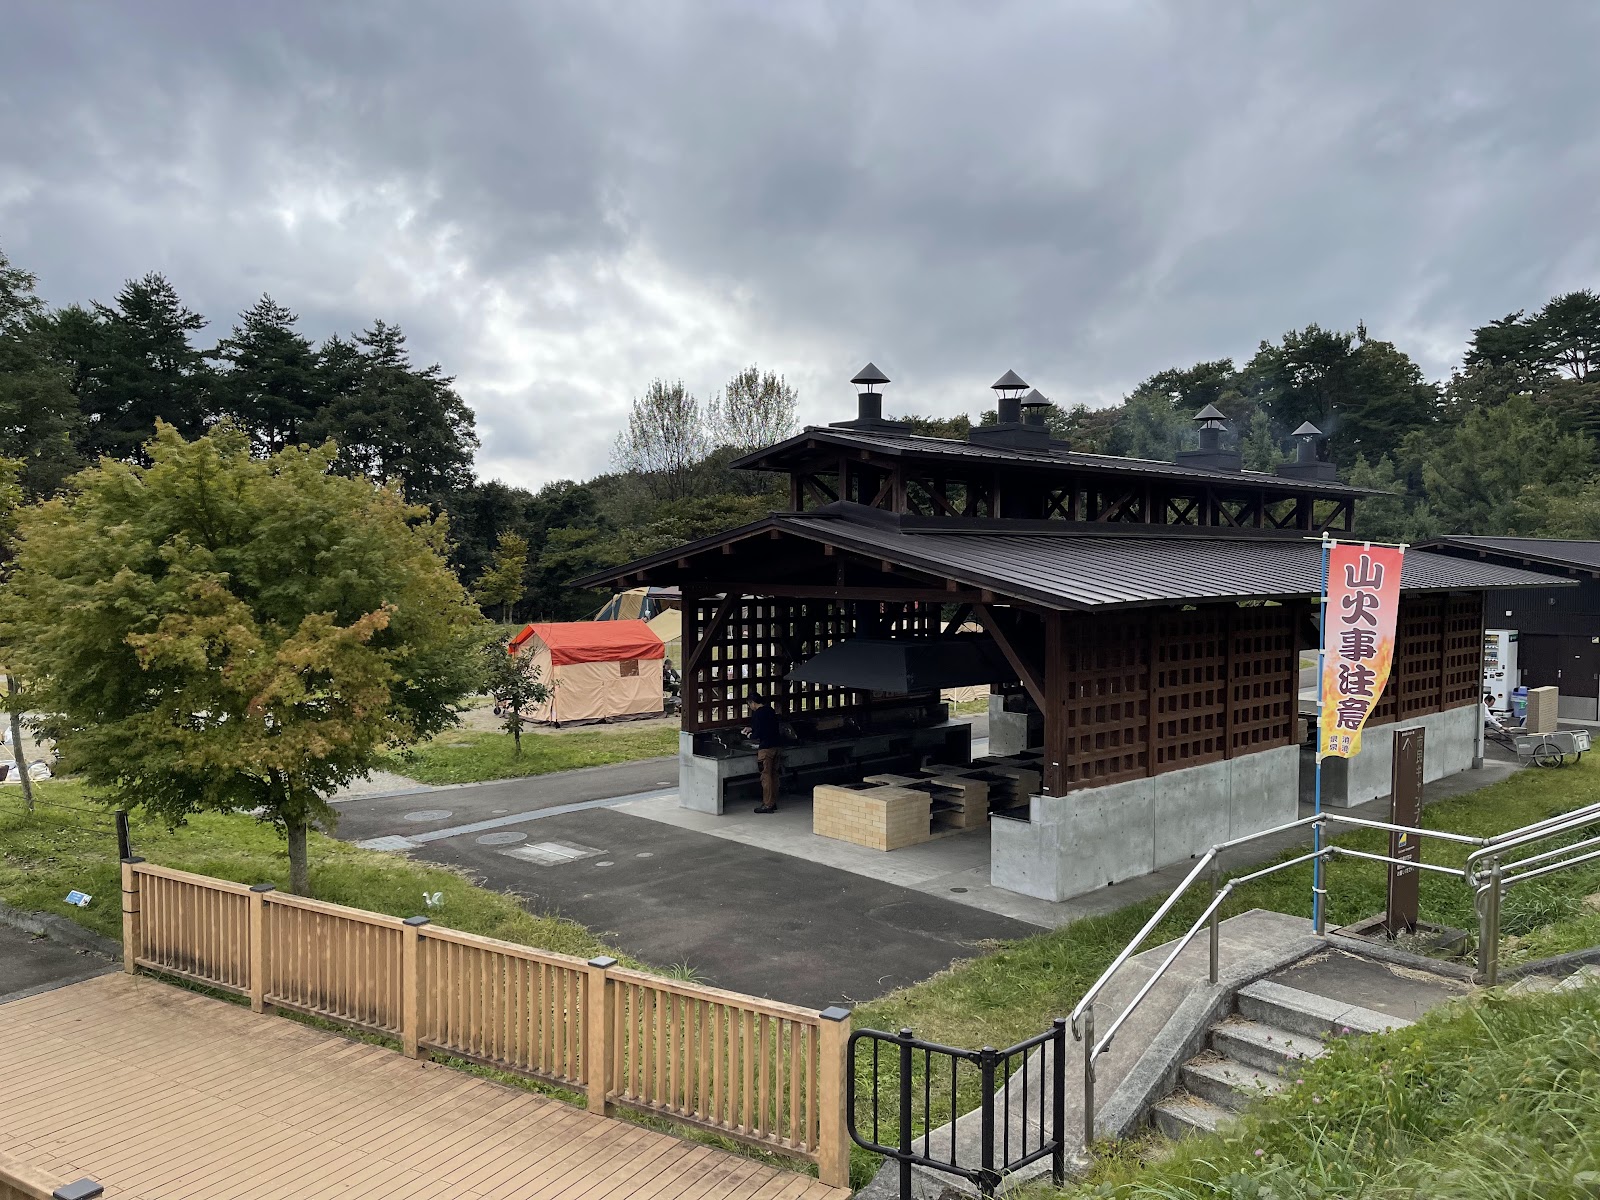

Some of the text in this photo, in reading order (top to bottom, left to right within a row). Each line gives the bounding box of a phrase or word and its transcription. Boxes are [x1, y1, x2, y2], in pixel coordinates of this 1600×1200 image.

[1337, 555, 1384, 730] 山火事注意
